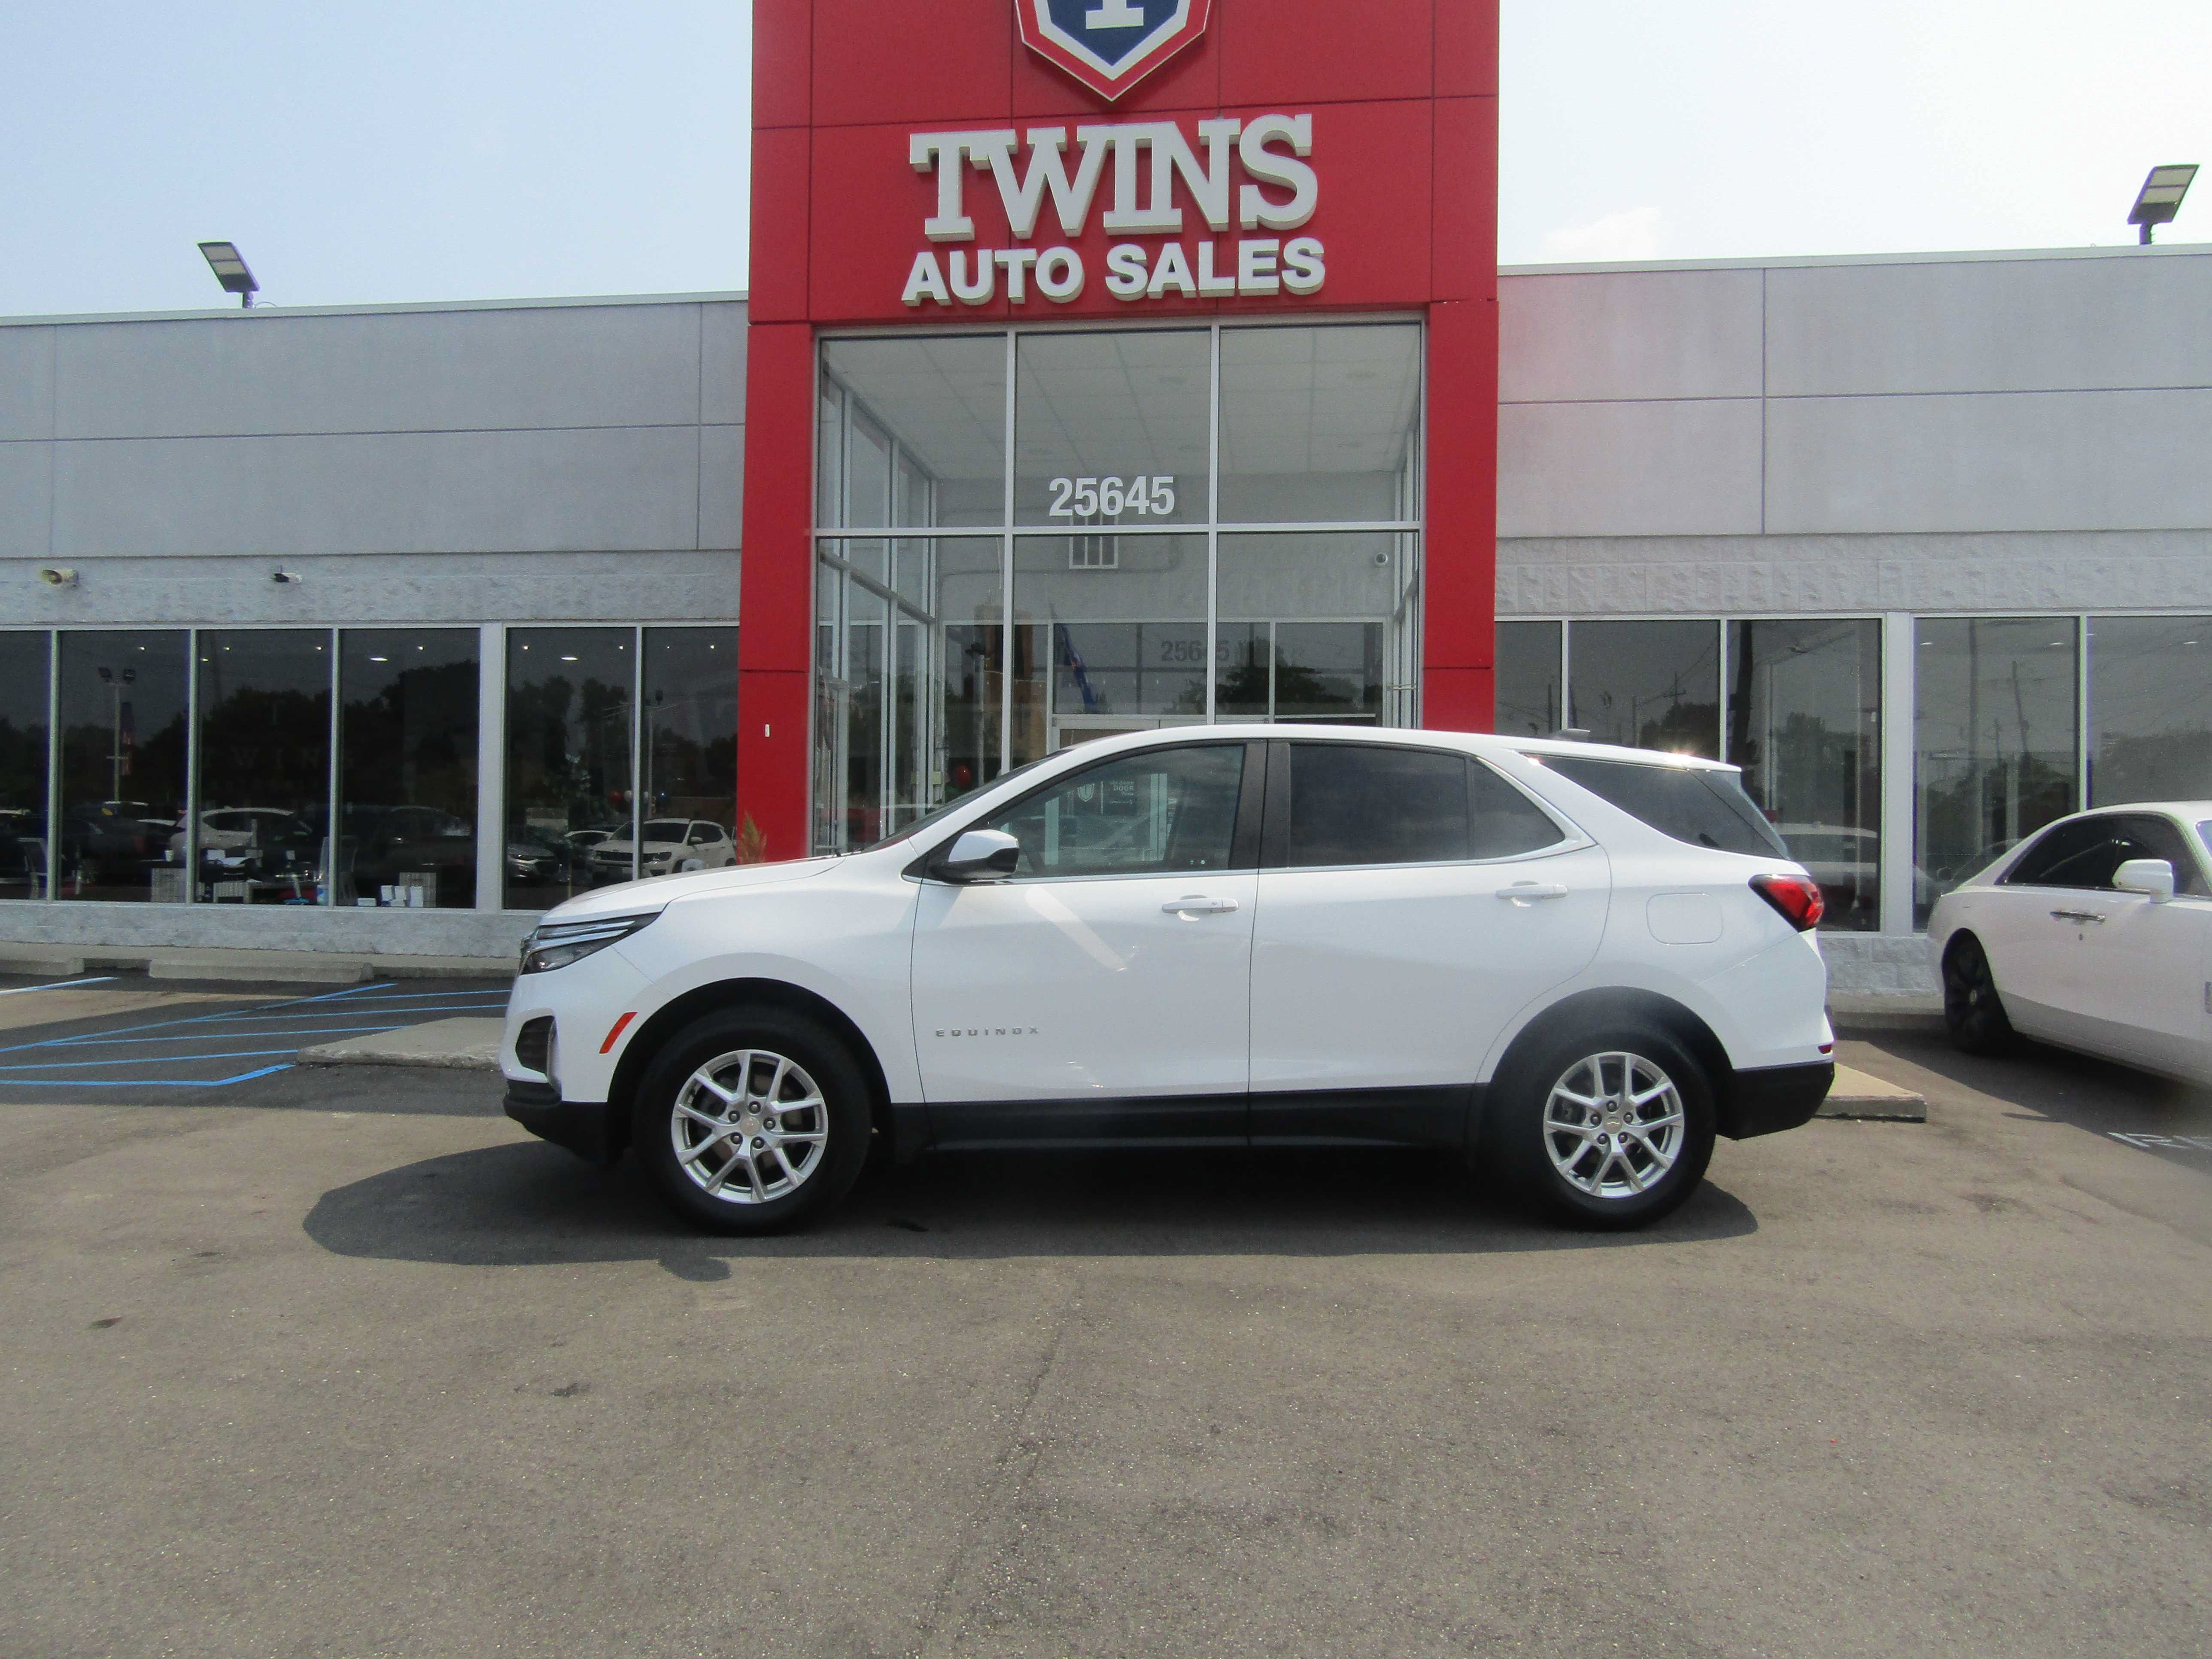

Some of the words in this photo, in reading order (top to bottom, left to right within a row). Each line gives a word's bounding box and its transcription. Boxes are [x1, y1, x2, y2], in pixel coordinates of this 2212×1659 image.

[909, 113, 1318, 242] TWINS
[901, 246, 1085, 307] AUTO
[1105, 237, 1325, 302] SALES
[1049, 475, 1175, 517] 25645
[1161, 639, 1230, 661] 2565
[935, 1025, 1039, 1037] EQUINOX
